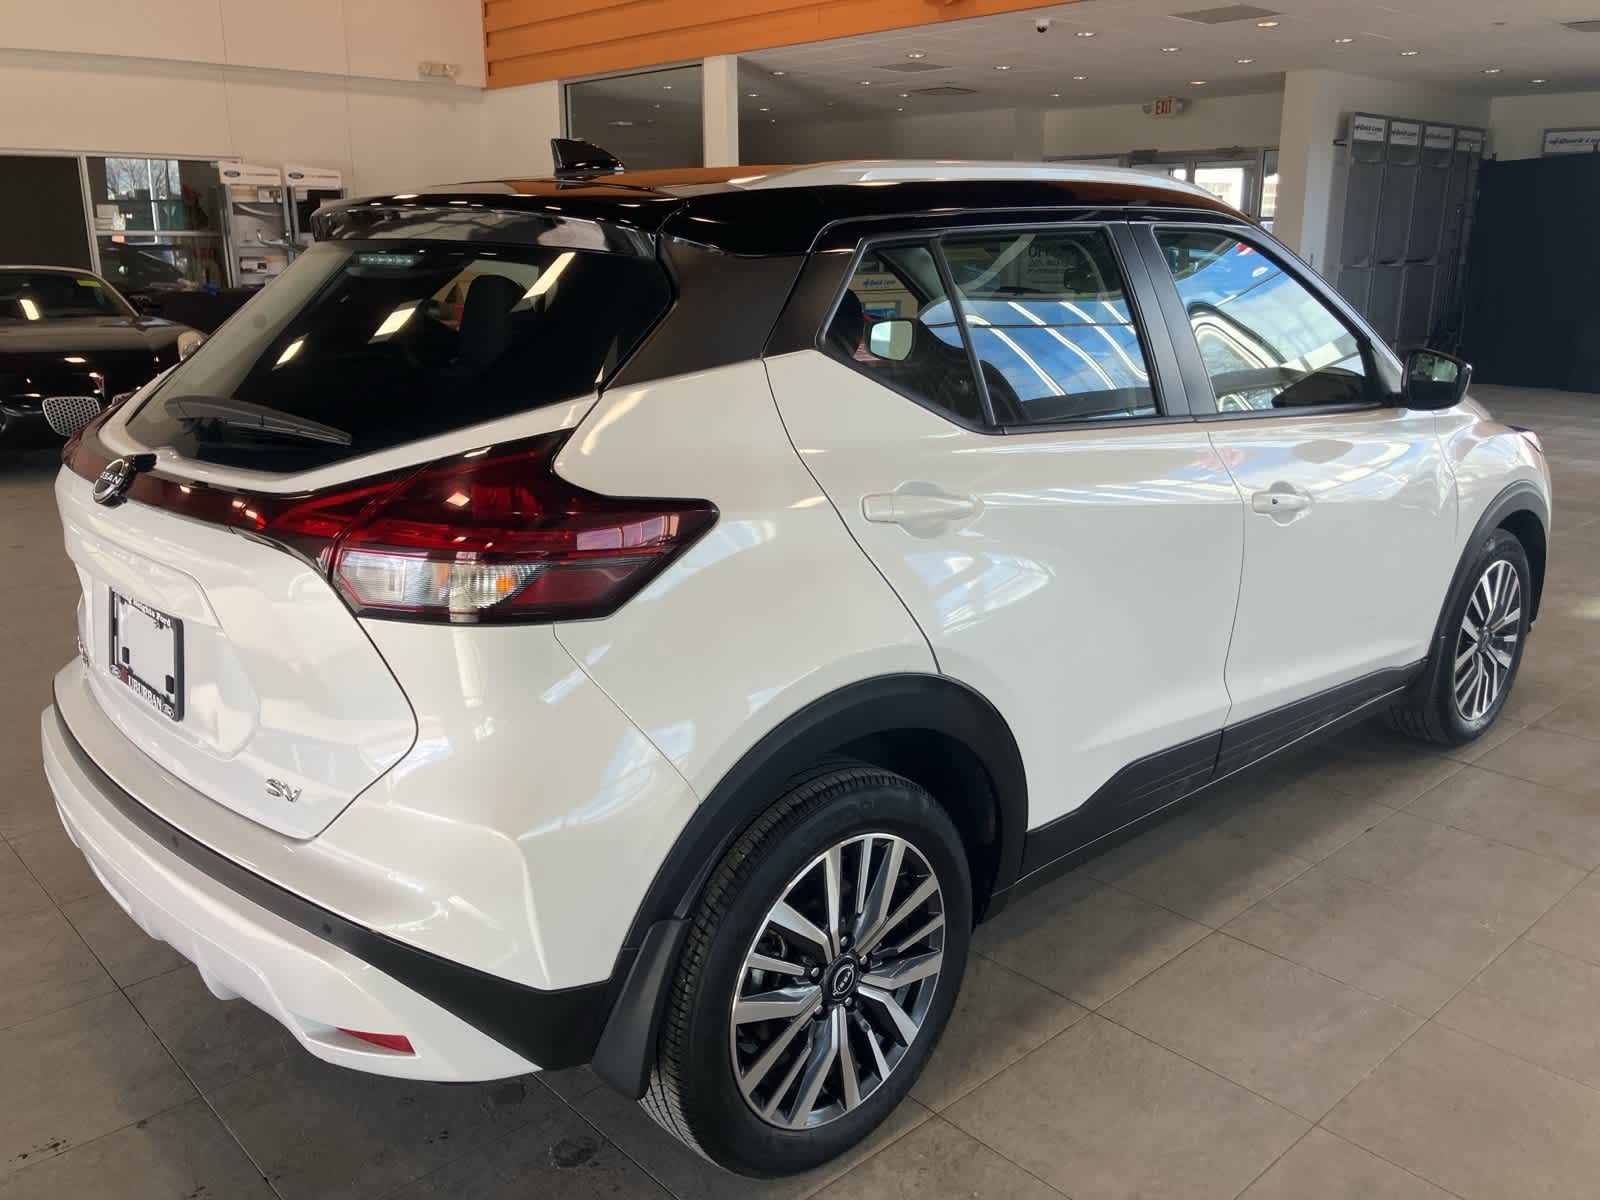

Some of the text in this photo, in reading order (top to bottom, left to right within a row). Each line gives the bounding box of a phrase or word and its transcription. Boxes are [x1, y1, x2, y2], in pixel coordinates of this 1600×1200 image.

[1155, 99, 1173, 115] EXIT
[127, 673, 162, 712] UBURBAN
[265, 778, 303, 802] SV
